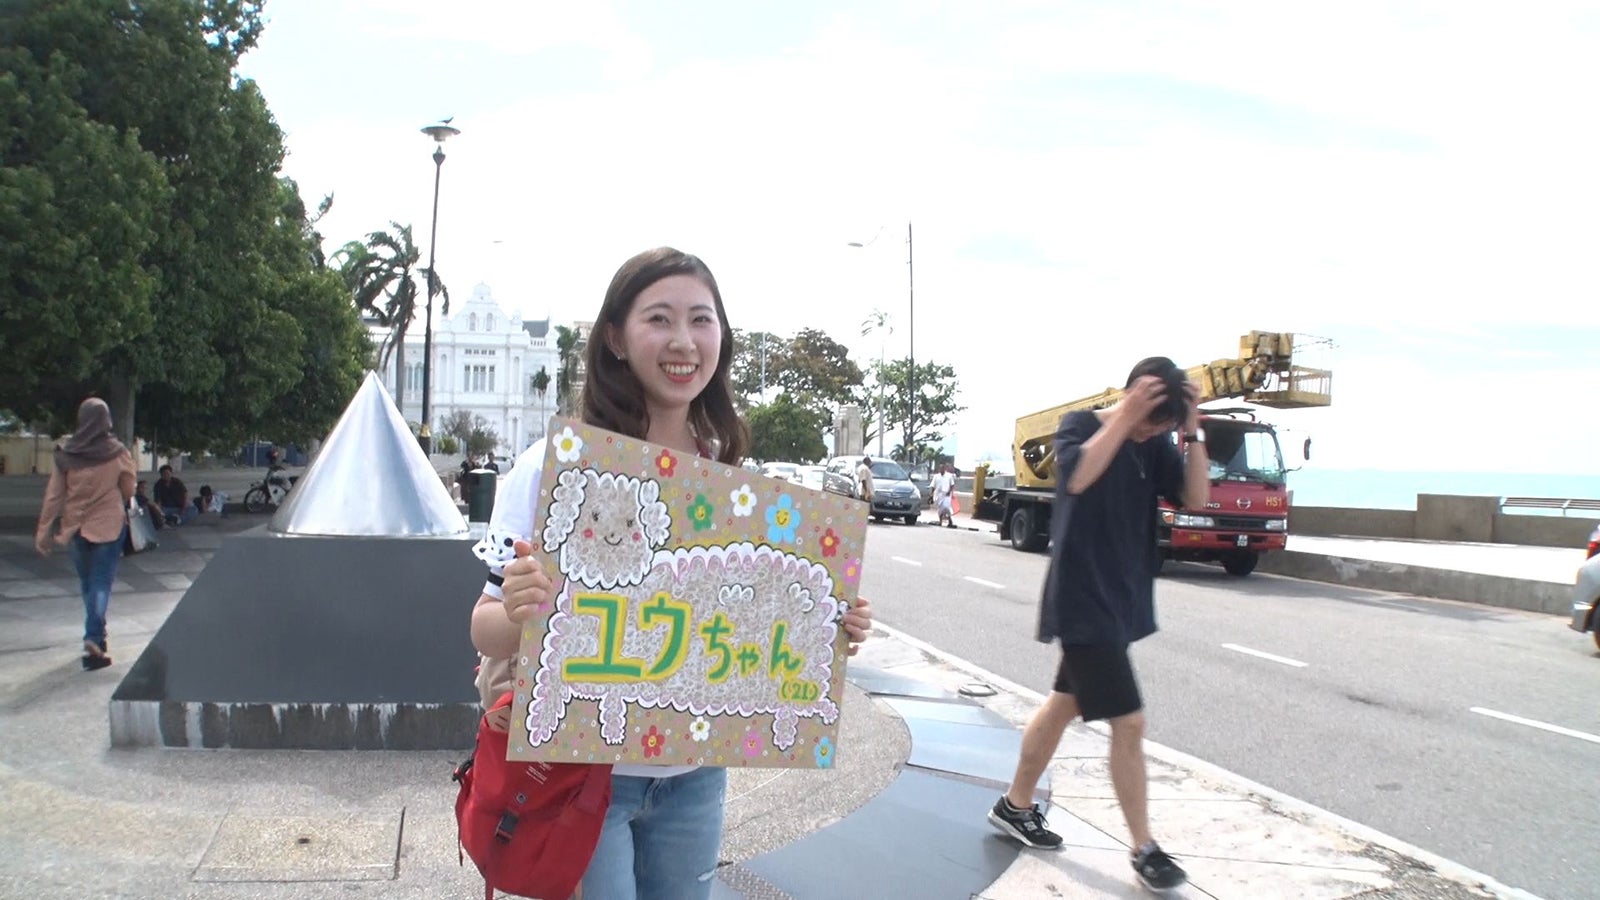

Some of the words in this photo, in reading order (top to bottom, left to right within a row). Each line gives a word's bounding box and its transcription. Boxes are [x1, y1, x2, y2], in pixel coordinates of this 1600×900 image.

[564, 594, 804, 682] ユウちゃん
[781, 680, 819, 701] (21)
